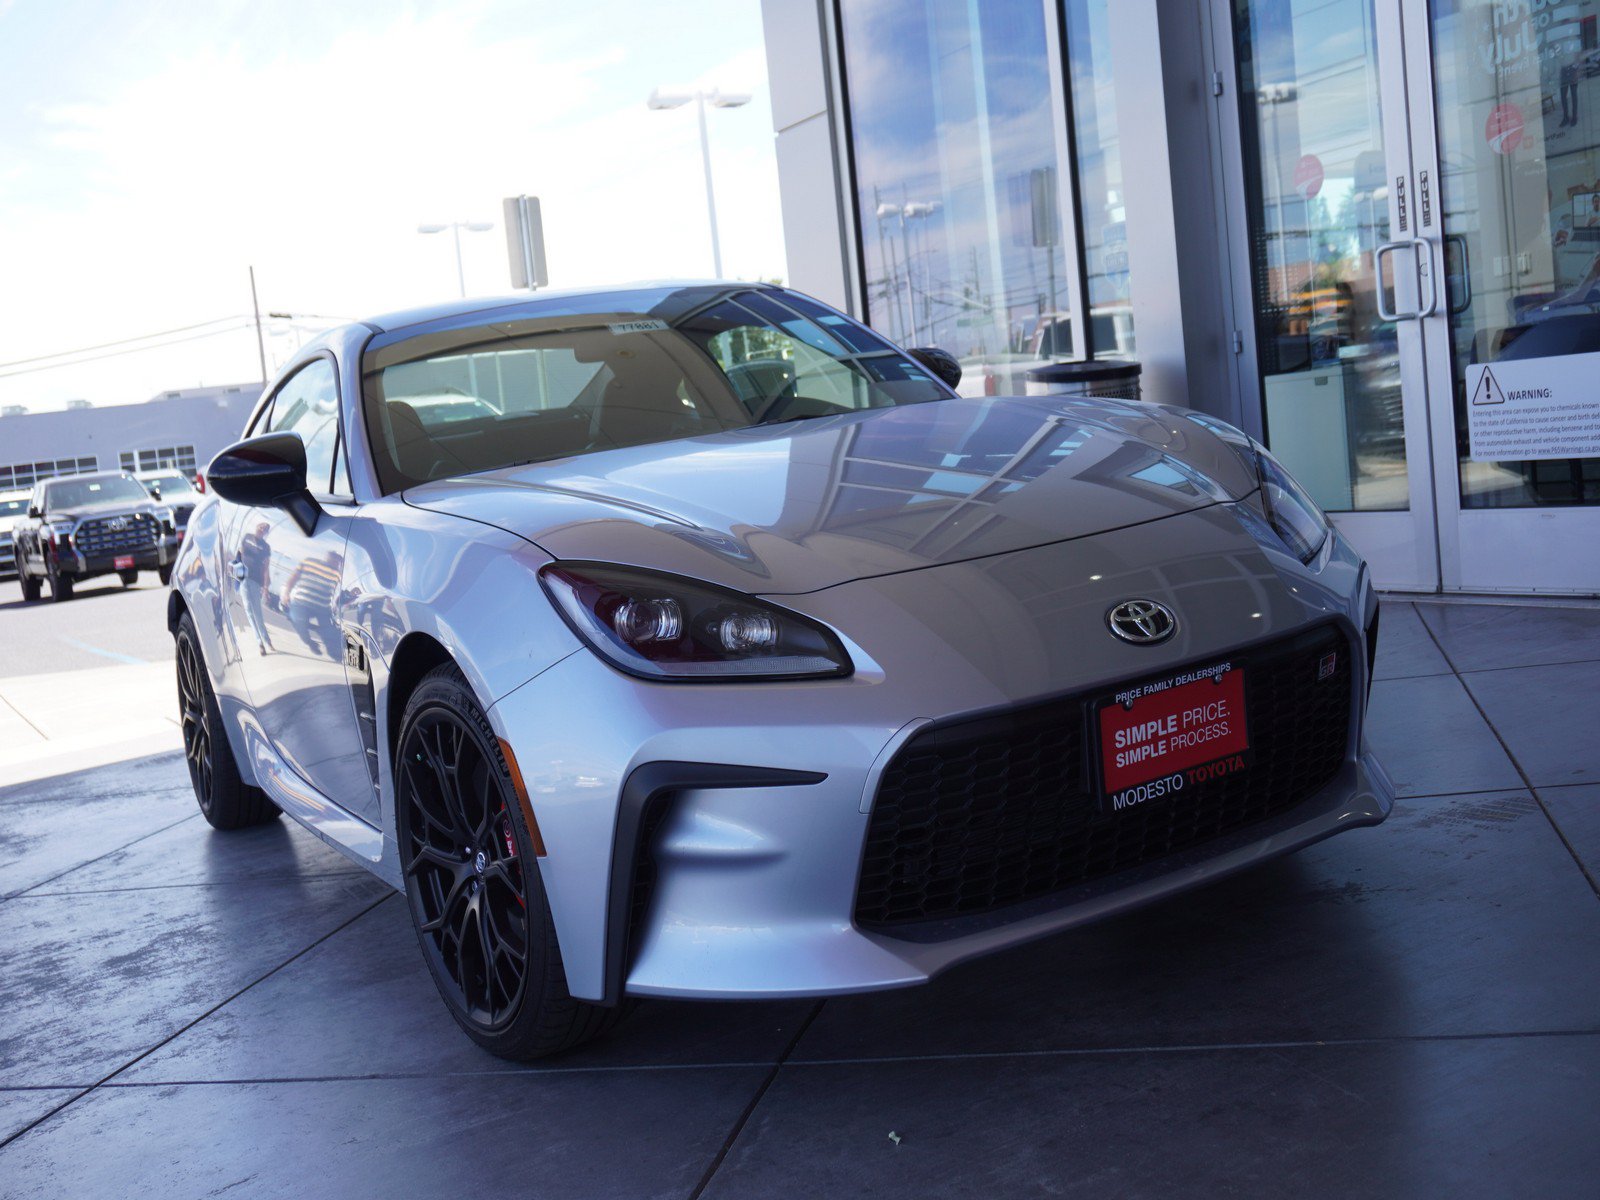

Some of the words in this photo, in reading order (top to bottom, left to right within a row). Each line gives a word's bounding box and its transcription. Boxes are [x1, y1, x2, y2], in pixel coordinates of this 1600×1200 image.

[1397, 177, 1406, 217] PULL
[1420, 171, 1430, 212] PULL
[1507, 388, 1553, 400] WARNING:
[1115, 688, 1142, 704] PRICE
[1143, 679, 1174, 694] FAMILY
[1175, 662, 1231, 686] DEALERSHIPS
[470, 707, 509, 771] MICHELIN
[1115, 714, 1178, 749] SIMPLE
[1182, 700, 1231, 728] PRICE.
[1115, 740, 1167, 769] SIMPLE
[1170, 721, 1232, 752] PROCESS.
[1113, 774, 1184, 811] MODESTO
[1187, 755, 1244, 785] TOYOTA
